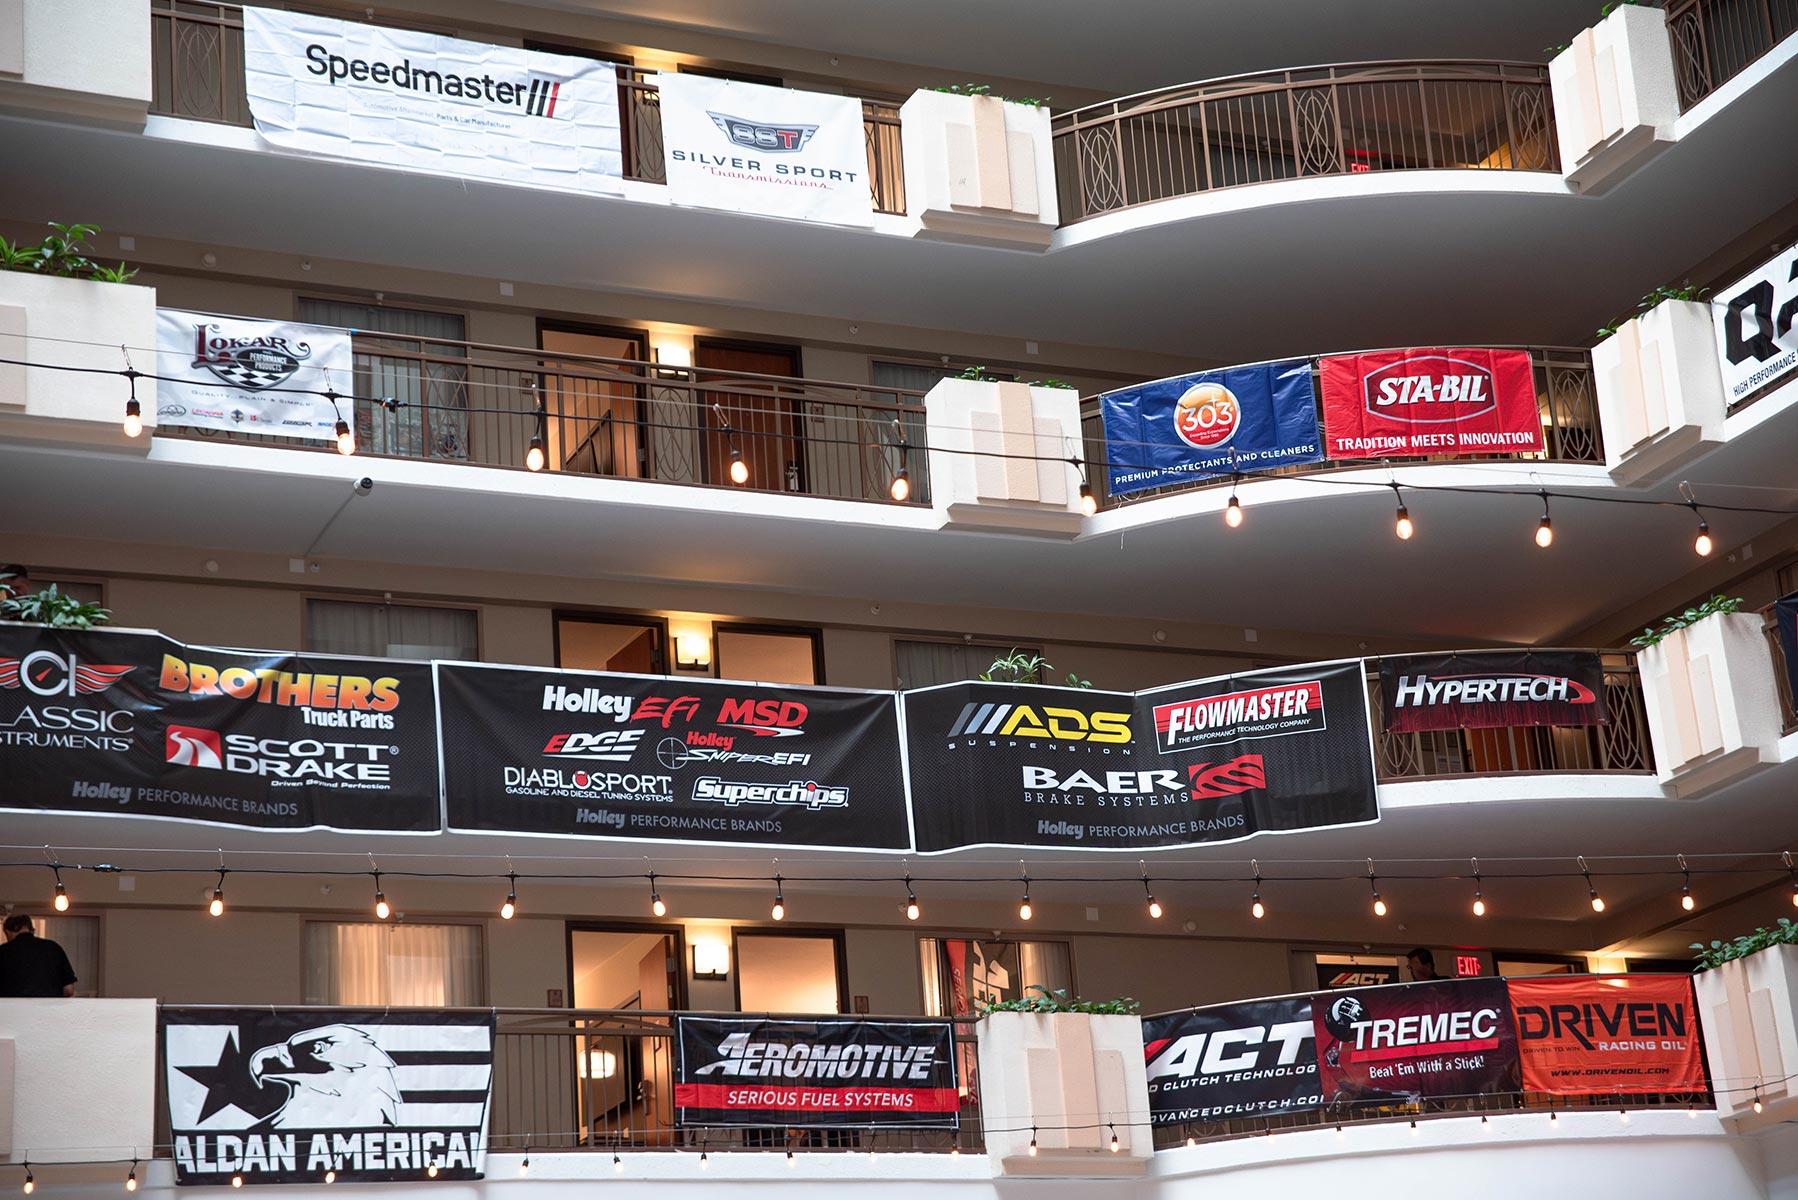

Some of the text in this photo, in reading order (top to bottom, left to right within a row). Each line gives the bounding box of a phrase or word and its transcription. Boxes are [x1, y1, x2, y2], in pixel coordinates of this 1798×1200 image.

[306, 44, 527, 106] Speedmaster
[672, 150, 858, 183] SILVER SPORT
[191, 323, 312, 369] LOKAR
[1733, 352, 1797, 397] HIGH PERFORMANCE
[1376, 375, 1488, 406] STA-BIL
[1181, 402, 1233, 431] 303
[1336, 431, 1534, 450] TRADITION MEETS INNOVATION
[1115, 444, 1315, 484] PREMIUM PROTECTANTS AND CLEANERS
[159, 653, 400, 712] BROTHERS
[1395, 674, 1569, 708] HYPERTECH
[301, 706, 395, 730] Truck Parts
[542, 685, 702, 729] Holley EFI
[716, 698, 809, 727] MSD
[1167, 687, 1310, 746] FLOWMASTER
[999, 704, 1132, 744] ADS
[1178, 718, 1311, 744] THE PERFORMANCE TECHNOLOGY COMPANY
[542, 729, 646, 753] EDGE
[686, 731, 735, 751] Holley
[948, 739, 1131, 755] SUSPENSION
[226, 754, 391, 781] DRAKE
[1022, 765, 1187, 795] BAER
[72, 781, 298, 816] Holley PERFORMANCE BRANDS
[340, 782, 391, 790] Perfection
[505, 786, 674, 803] GASOLINE AND DIESEL TUNING SYSTEMS
[694, 776, 848, 809] Superchips
[1024, 792, 1189, 807] BRAKE SYSTEMS
[576, 808, 782, 833] Holley PERFORMANCE BRANDS
[1037, 814, 1245, 840] Holley PERFORMANCE BRANDS
[1457, 955, 1479, 977] EXIT
[1350, 1008, 1498, 1050] TREMEC
[1516, 1003, 1687, 1050] DRIVEN
[694, 1032, 937, 1080] AEROMOTIVE
[1146, 1020, 1316, 1082] ACT
[1599, 1041, 1686, 1051] RACING OIL
[1369, 1055, 1485, 1079] Beat 'Em With a Stick!
[1551, 1067, 1670, 1077] WWW.DRIVENOIL.COM
[1163, 1075, 1220, 1092] CLUTCH
[727, 1090, 914, 1108] SERIOUS FUEL SYSTEMS
[174, 1134, 298, 1173] ALDAN
